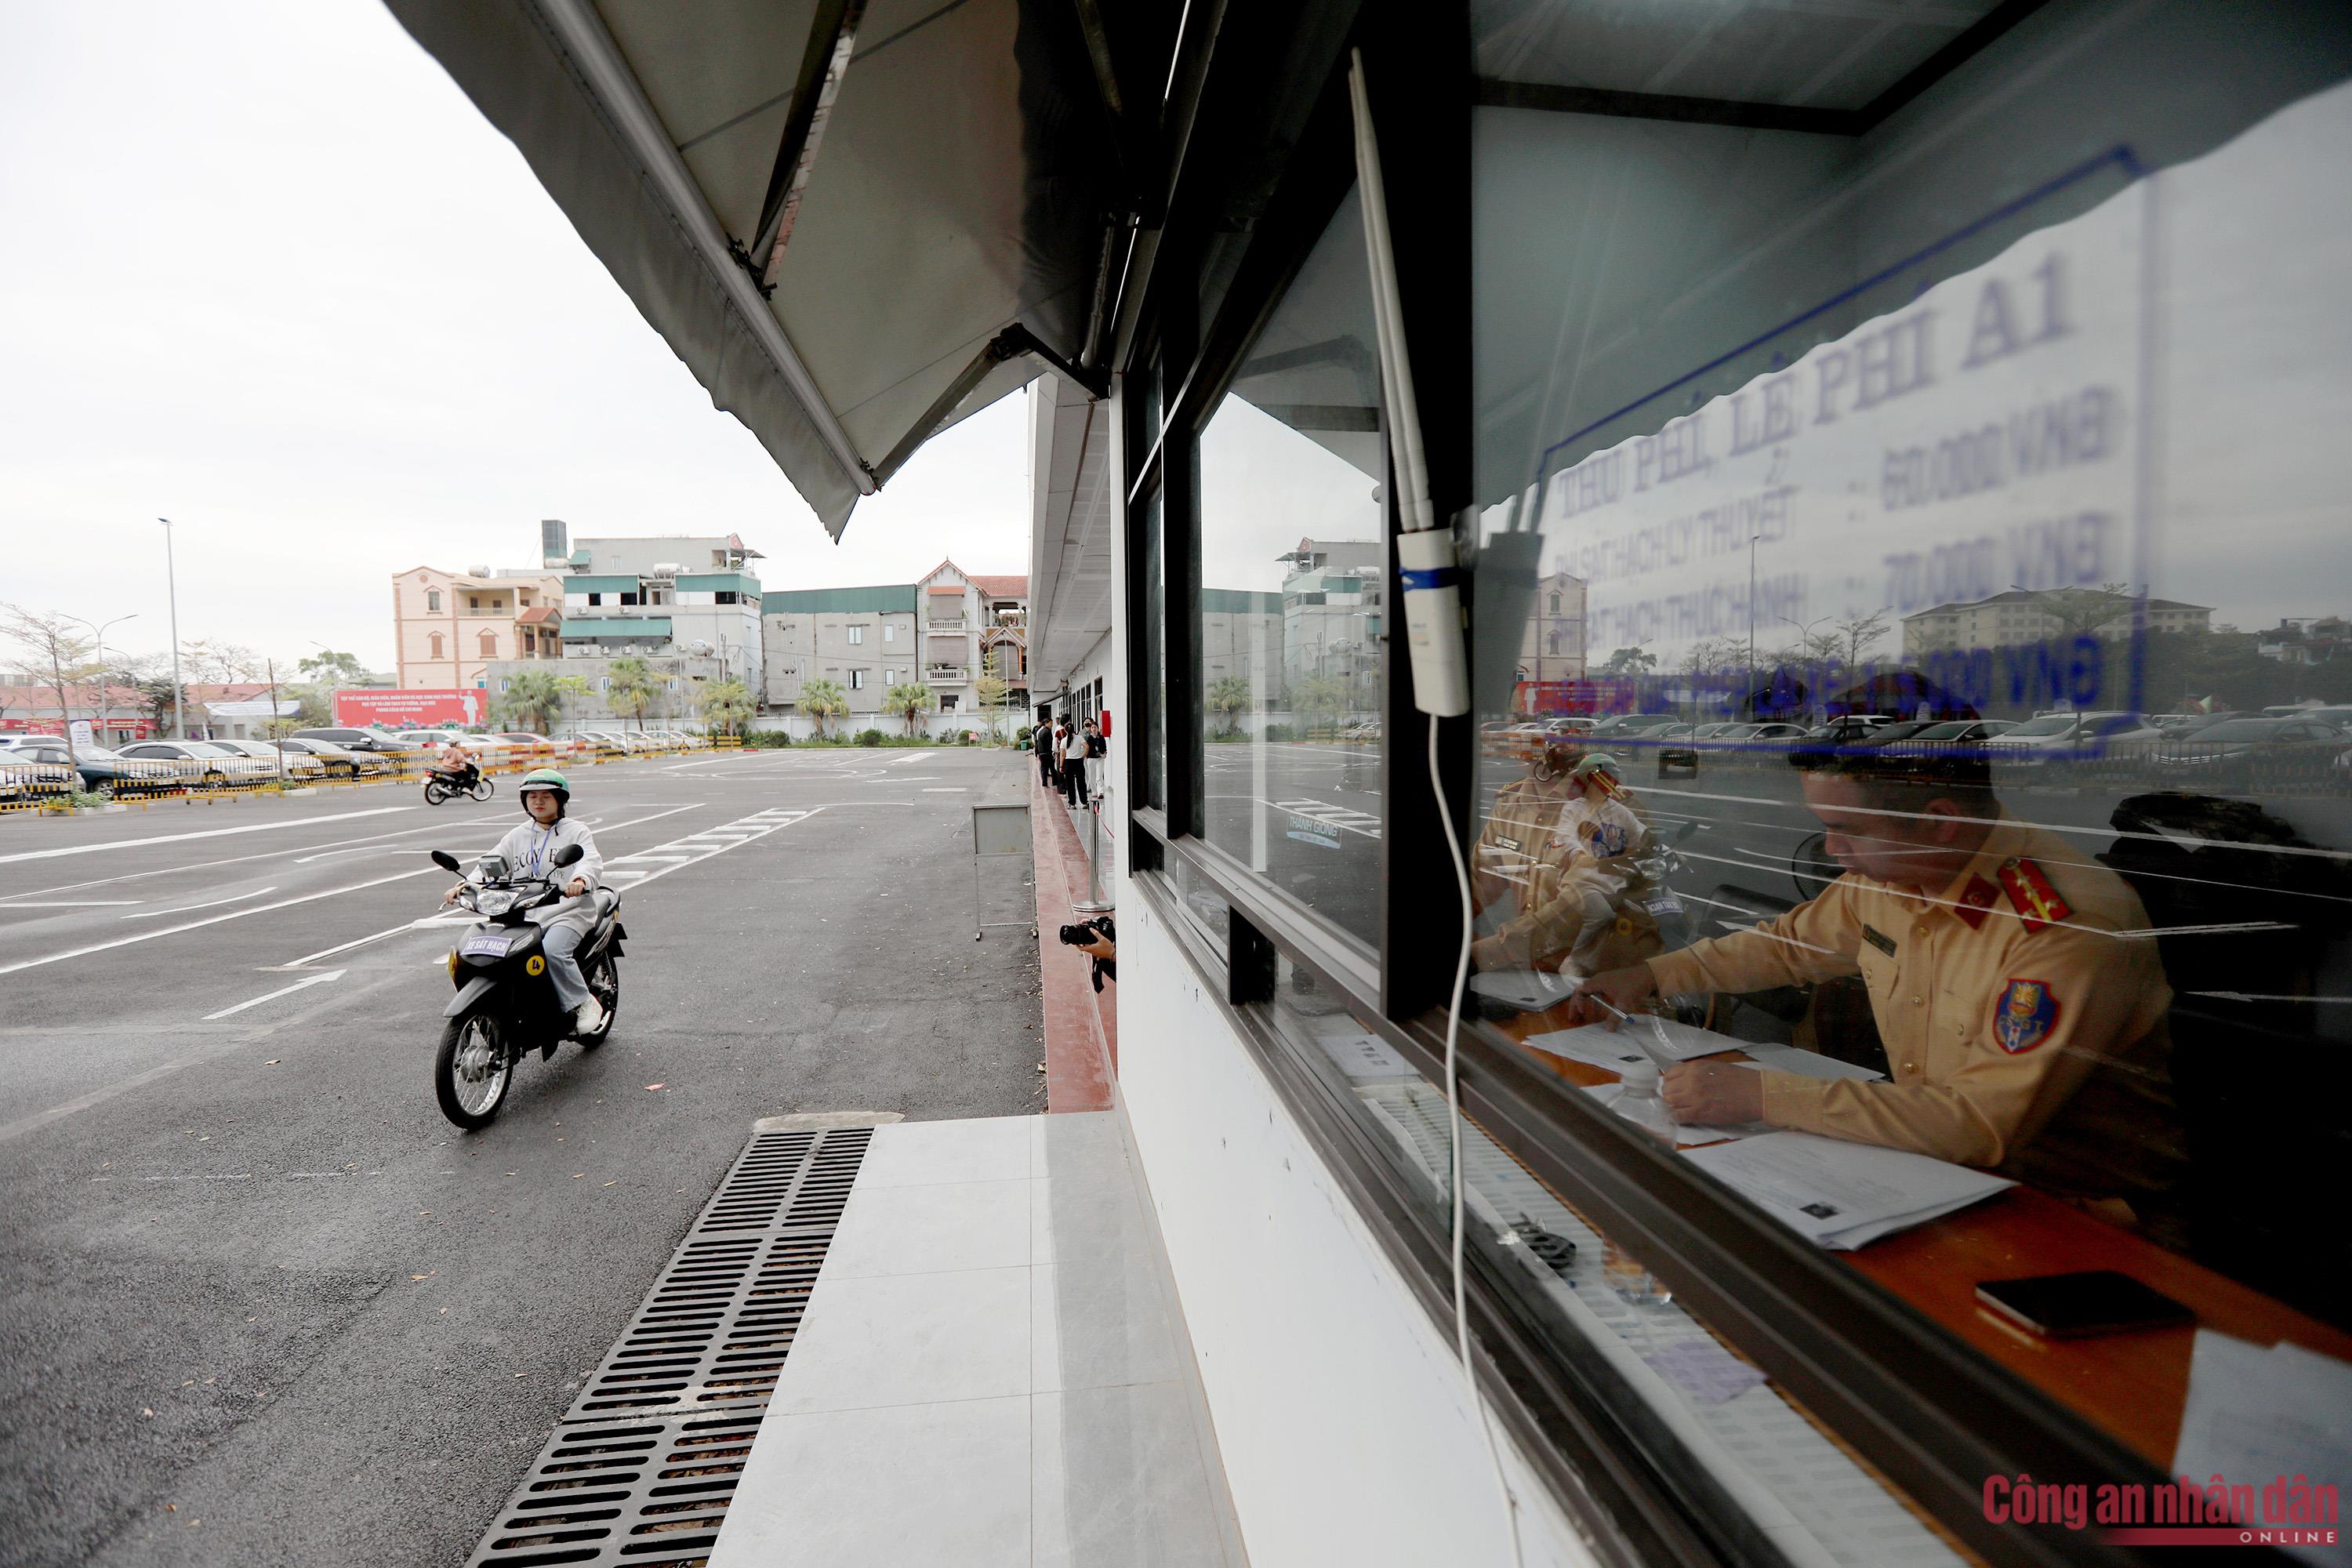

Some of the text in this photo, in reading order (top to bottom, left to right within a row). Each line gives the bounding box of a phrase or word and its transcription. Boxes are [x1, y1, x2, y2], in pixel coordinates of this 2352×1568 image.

[1559, 447, 1626, 519] THU
[1964, 250, 2074, 370] A1
[474, 939, 488, 949] SÁT
[487, 941, 507, 952] HẠCH
[532, 960, 541, 970] 4
